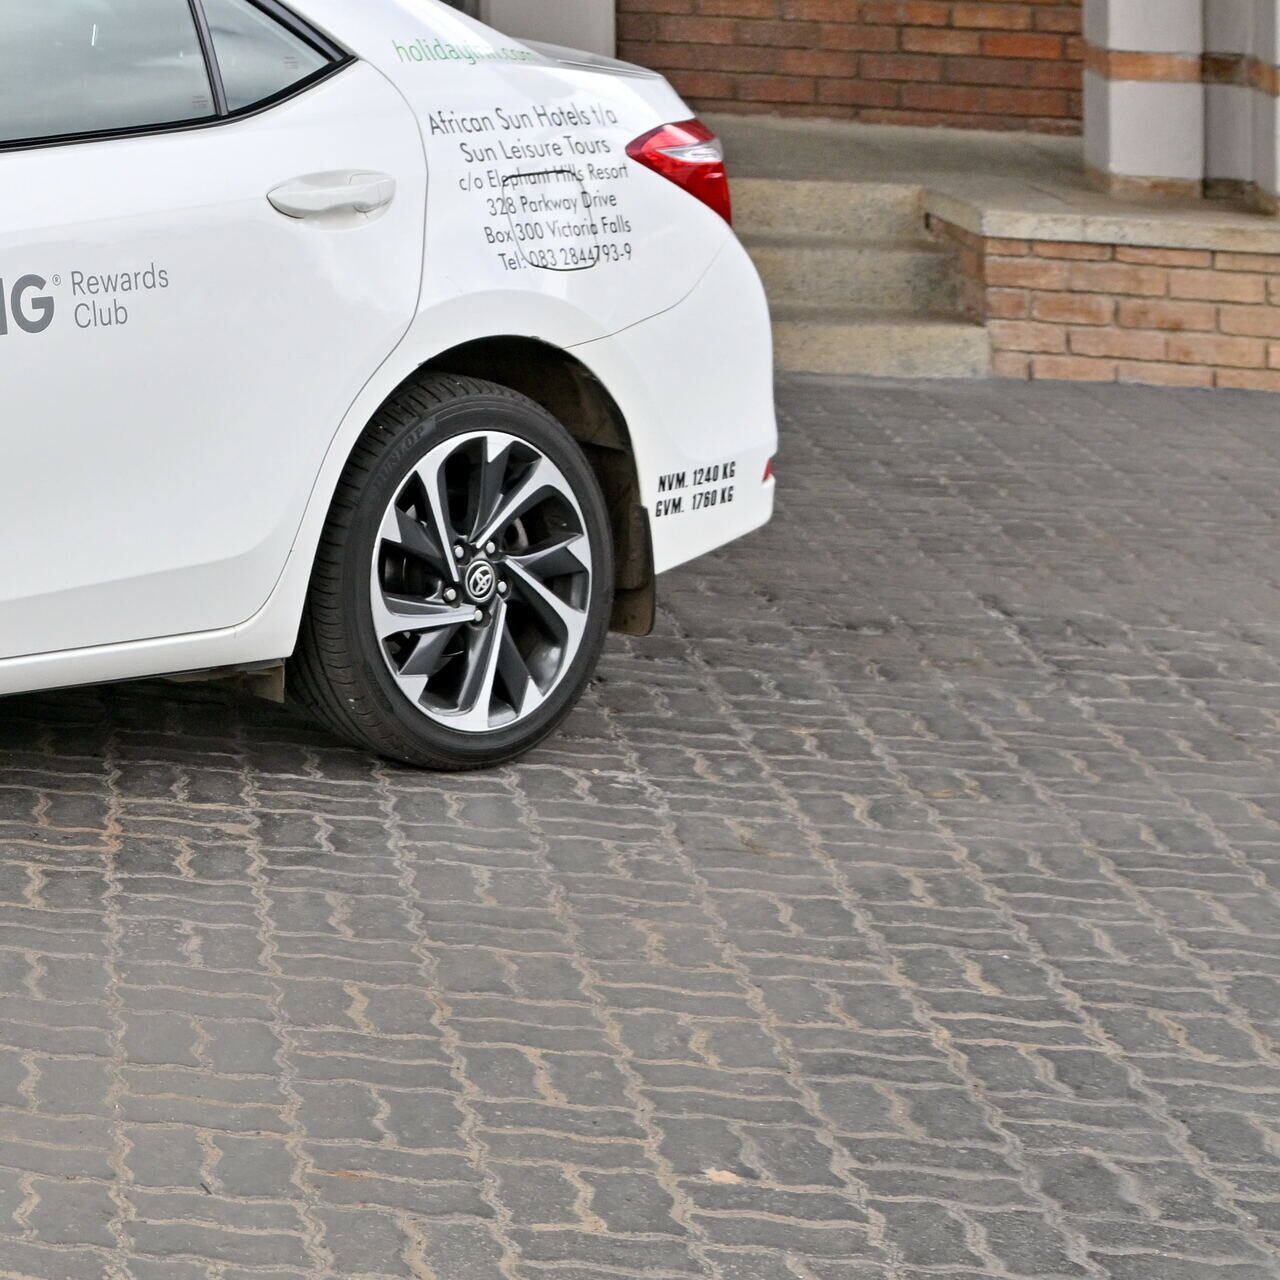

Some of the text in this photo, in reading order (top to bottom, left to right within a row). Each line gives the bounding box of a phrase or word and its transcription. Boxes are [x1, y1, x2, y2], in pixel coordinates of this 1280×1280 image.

[428, 102, 619, 136] African Sun Hotels t/a
[460, 136, 610, 163] Sun Leisure Tours
[458, 163, 629, 192] c/o Elephant Hills Resort
[486, 191, 618, 216] 328 Parkway Drive
[484, 216, 632, 244] Box 300 Victoria Falls
[498, 244, 632, 272] Tel: 083 2844793-9
[71, 262, 169, 296] Rewards
[74, 298, 129, 329] Club
[657, 460, 737, 493] NVM. 1240 KG
[655, 485, 735, 517] GVM. 1760 KG
